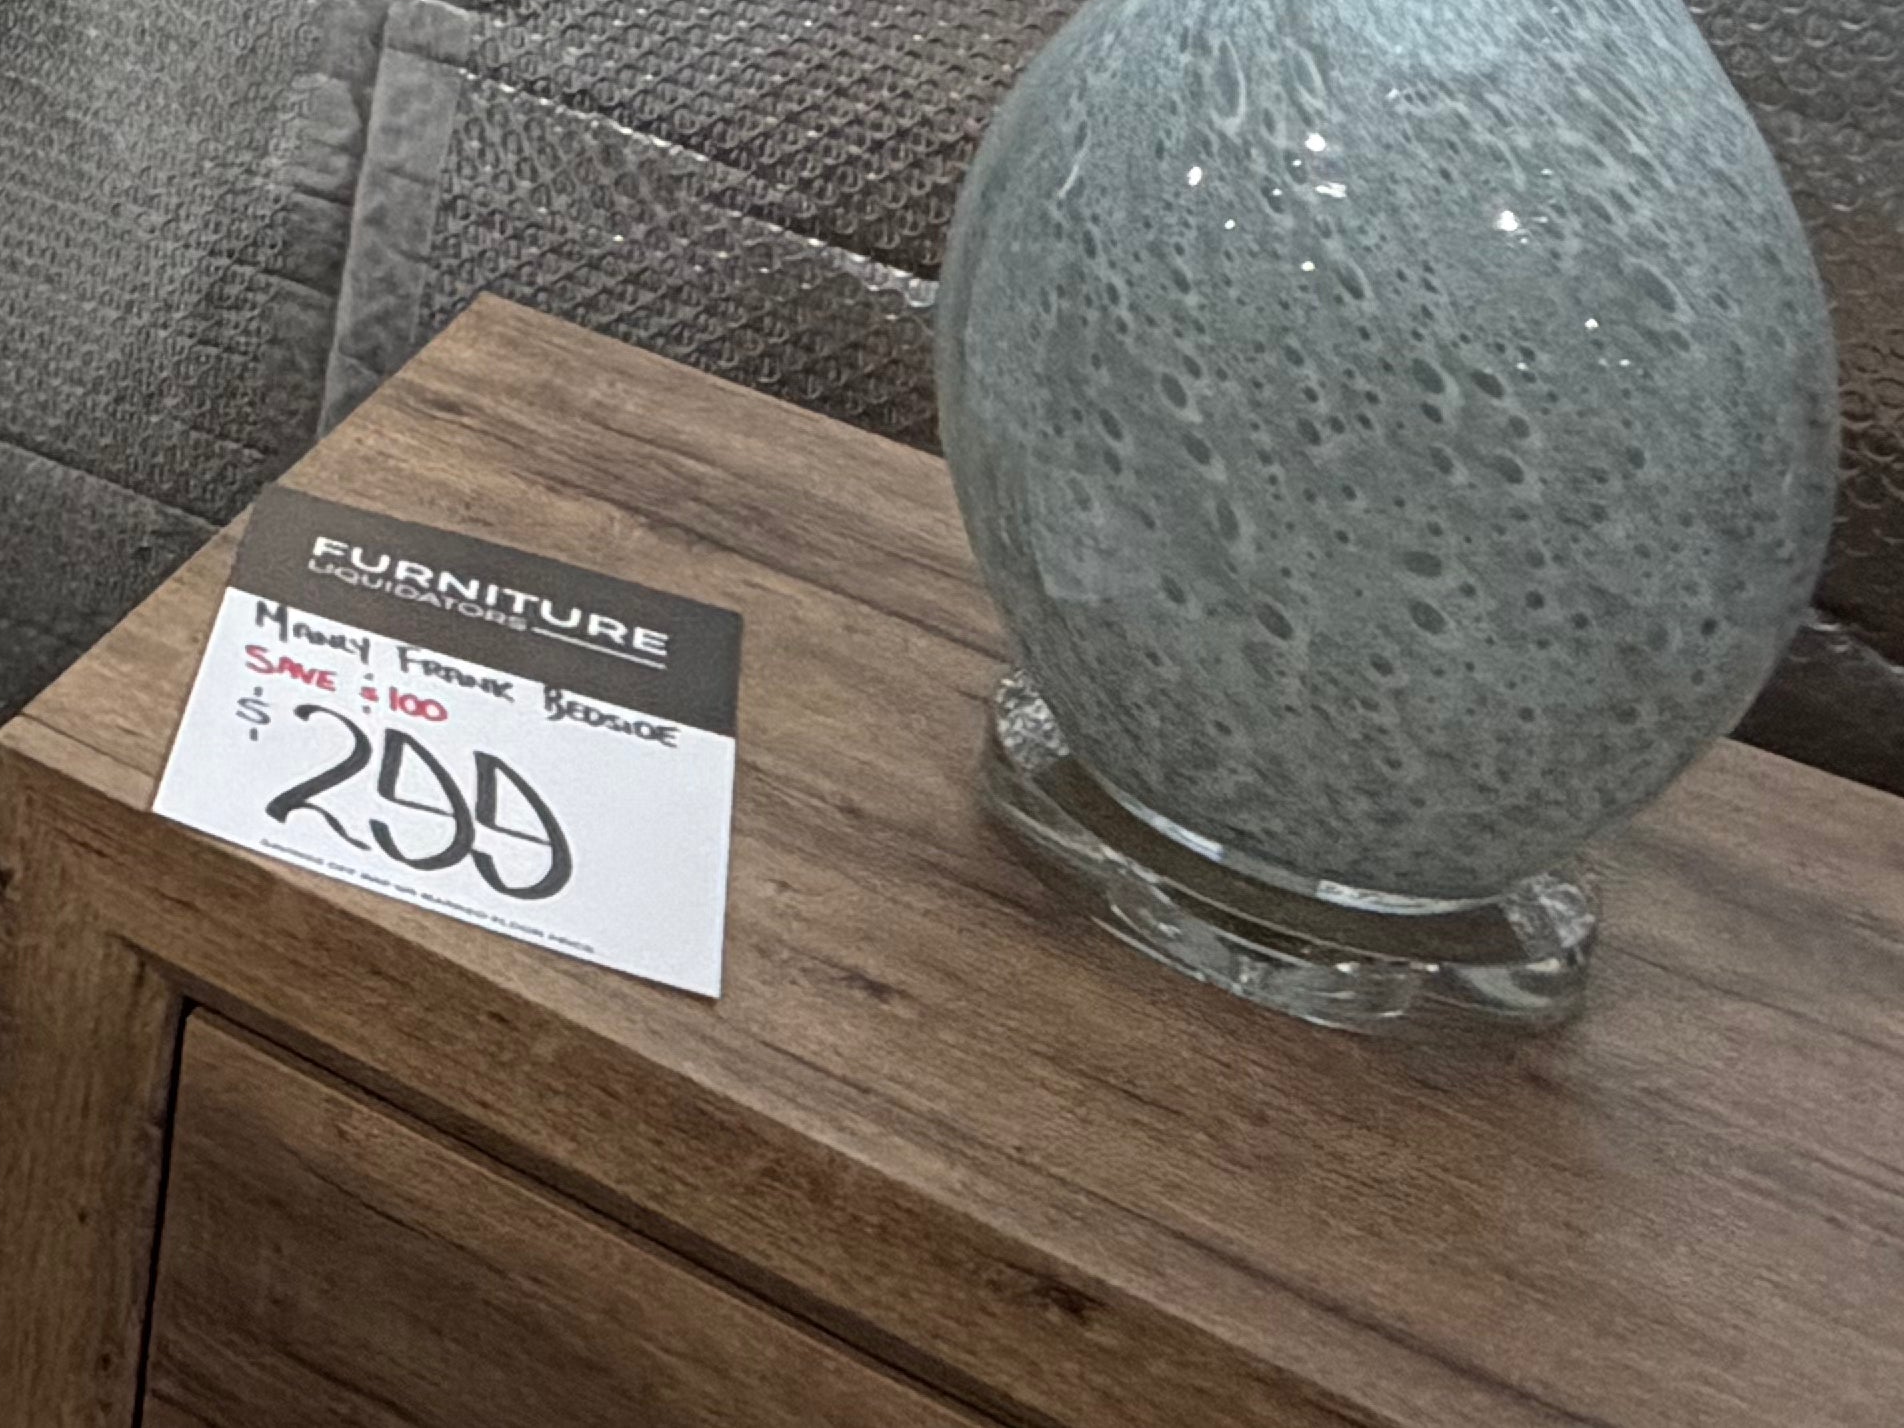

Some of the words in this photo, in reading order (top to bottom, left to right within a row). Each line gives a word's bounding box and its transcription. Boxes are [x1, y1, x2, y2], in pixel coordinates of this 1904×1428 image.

[308, 559, 528, 631] LIQUIDATORS
[312, 536, 669, 656] FURNITURE
[245, 644, 336, 691] SAVE
